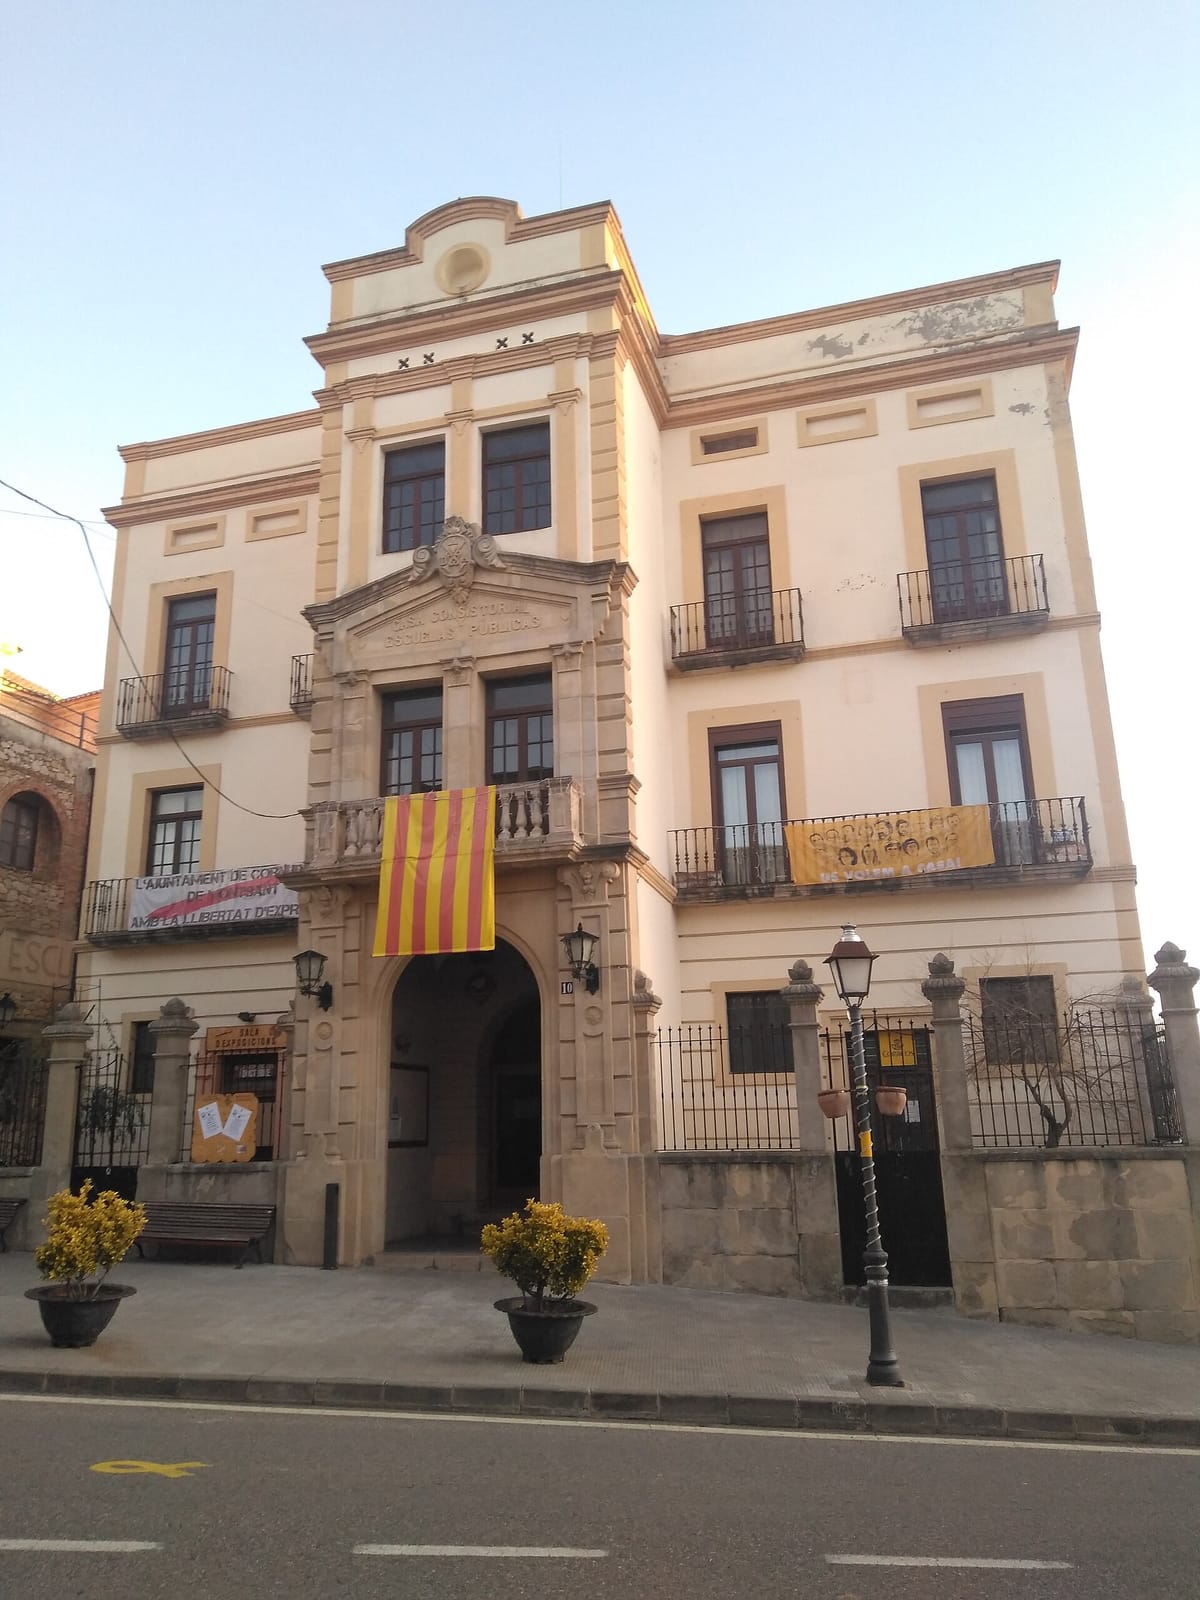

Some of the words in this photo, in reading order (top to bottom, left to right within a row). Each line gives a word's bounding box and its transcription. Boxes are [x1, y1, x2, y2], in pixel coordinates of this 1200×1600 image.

[392, 614, 424, 632] CASA
[432, 601, 530, 624] CONSISTORIAL
[384, 628, 455, 648] ESCUELAS
[469, 617, 541, 640] PUBLICAS
[135, 870, 225, 890] L'AJUNTAMENT
[230, 868, 248, 882] DE
[844, 866, 895, 881] VOLEM
[902, 864, 912, 875] A
[917, 857, 961, 873] CASA!
[130, 916, 159, 929] AMB
[182, 907, 252, 924] LLIBERTAT
[562, 982, 573, 994] 10
[239, 1028, 259, 1038] SALA
